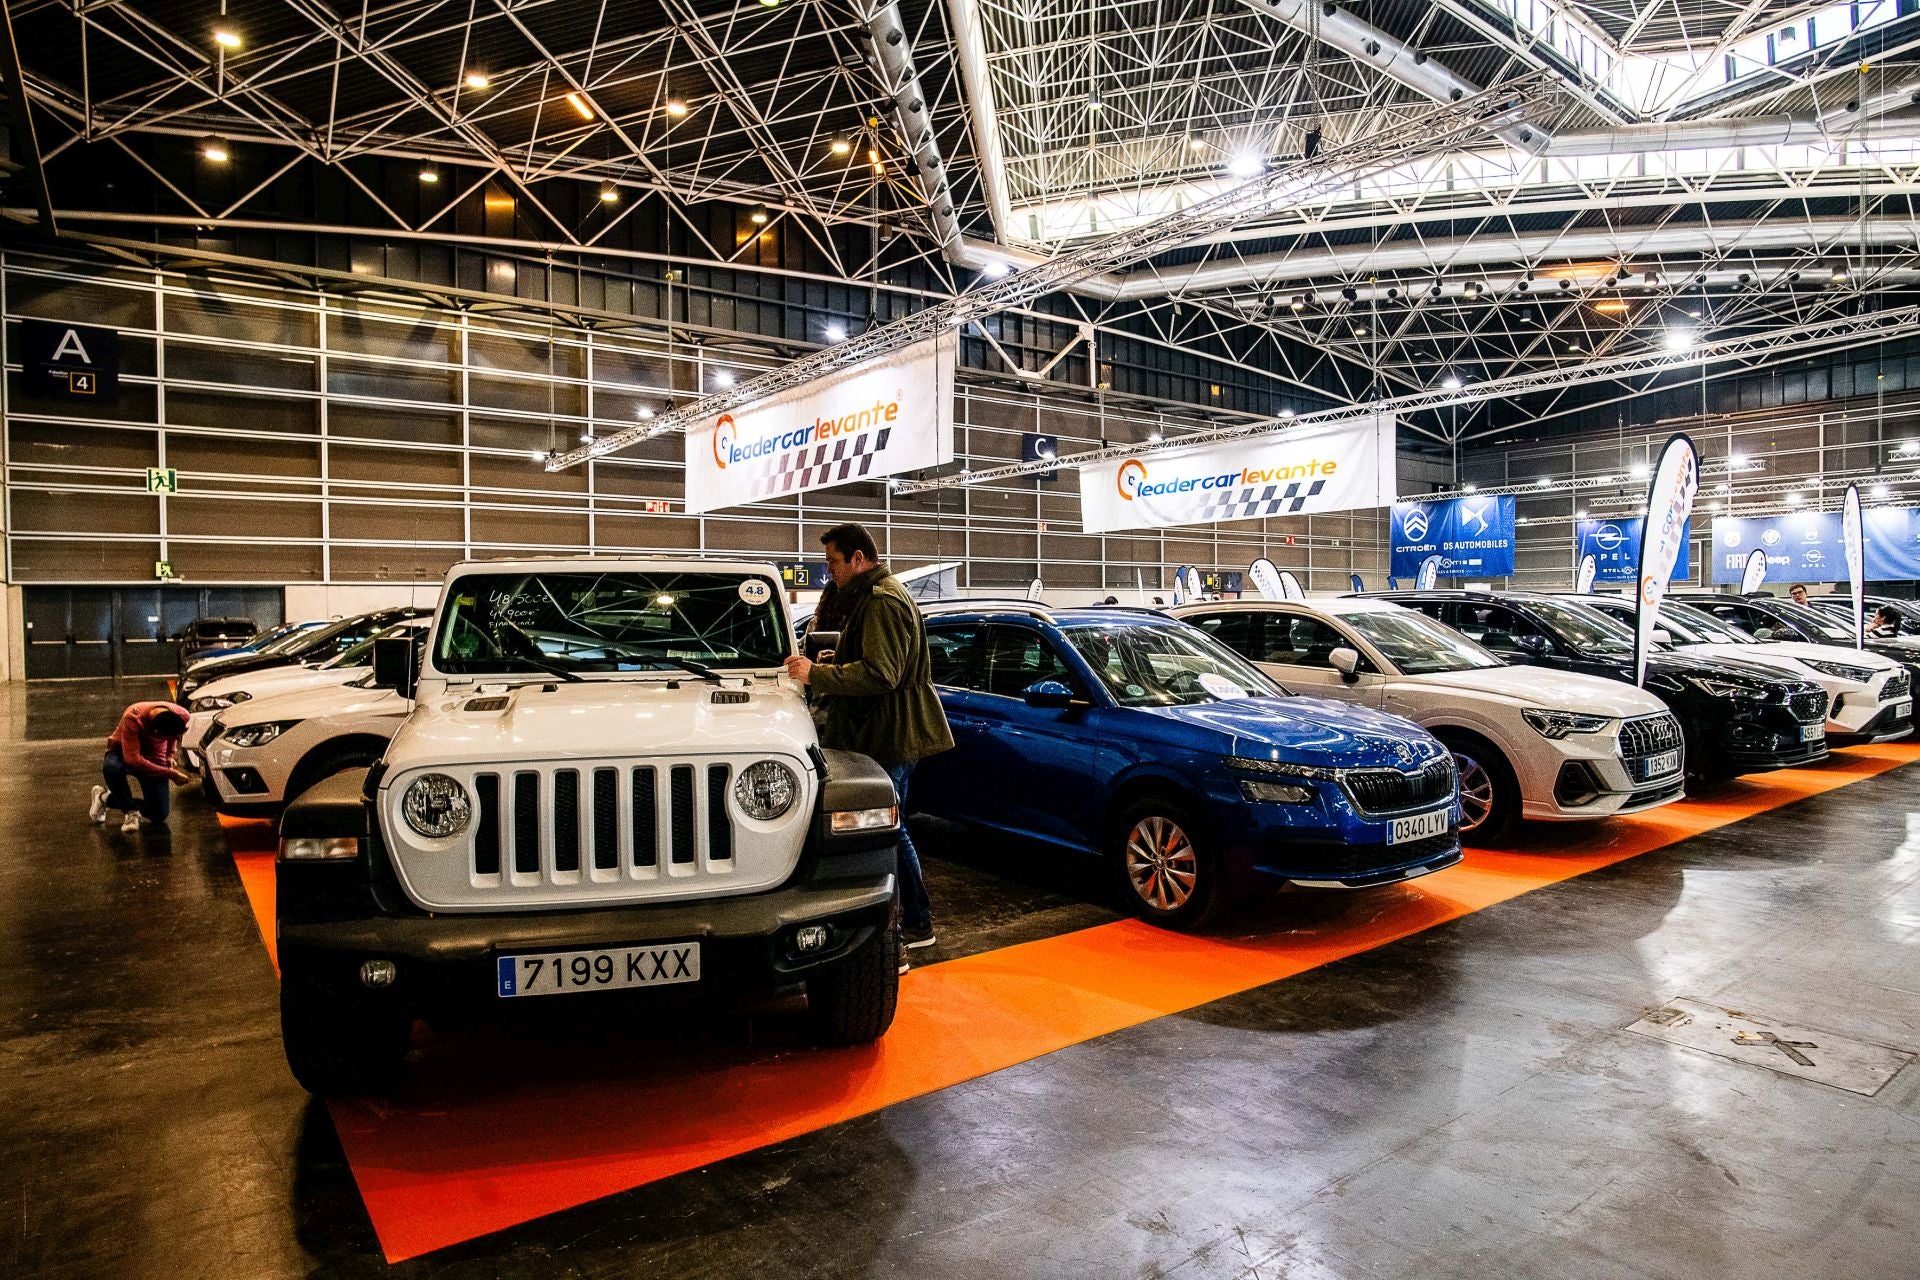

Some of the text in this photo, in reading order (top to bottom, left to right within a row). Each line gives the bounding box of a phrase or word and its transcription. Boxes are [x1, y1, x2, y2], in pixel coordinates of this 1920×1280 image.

[52, 329, 91, 364] A
[77, 376, 89, 390] 4
[728, 399, 899, 464] leadercarlevante
[1137, 458, 1337, 498] leadercarlevante
[1443, 539, 1509, 550] DS AUTOMOBILES
[1593, 552, 1631, 560] PEL
[1726, 553, 1748, 569] FIAT
[798, 572, 805, 583] 2
[1395, 812, 1446, 840] 0340 LYV
[524, 955, 614, 990] 7199
[626, 948, 692, 982] KXX
